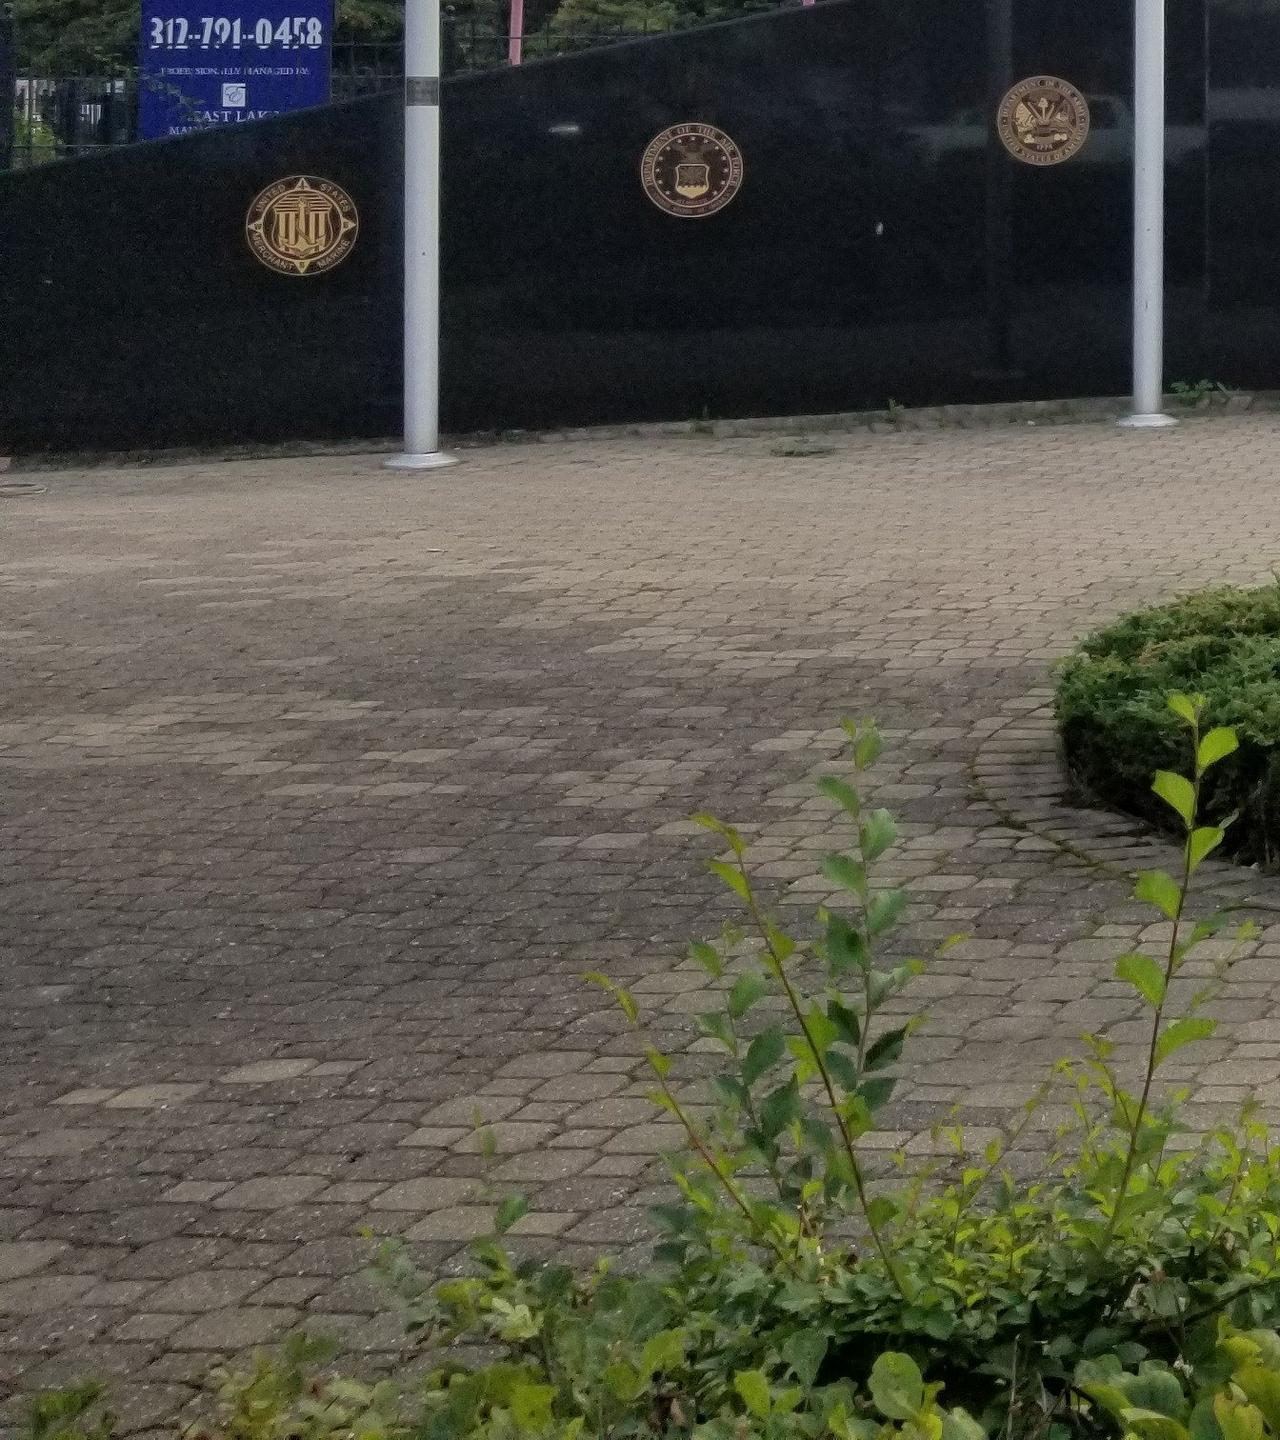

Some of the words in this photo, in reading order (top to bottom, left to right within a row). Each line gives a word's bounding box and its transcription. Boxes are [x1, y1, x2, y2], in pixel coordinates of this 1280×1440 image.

[235, 111, 279, 123] LAK
[255, 183, 287, 212] UNITED
[319, 183, 351, 212] STATES
[252, 232, 295, 271] MERCHANT
[315, 239, 351, 268] MARINE
